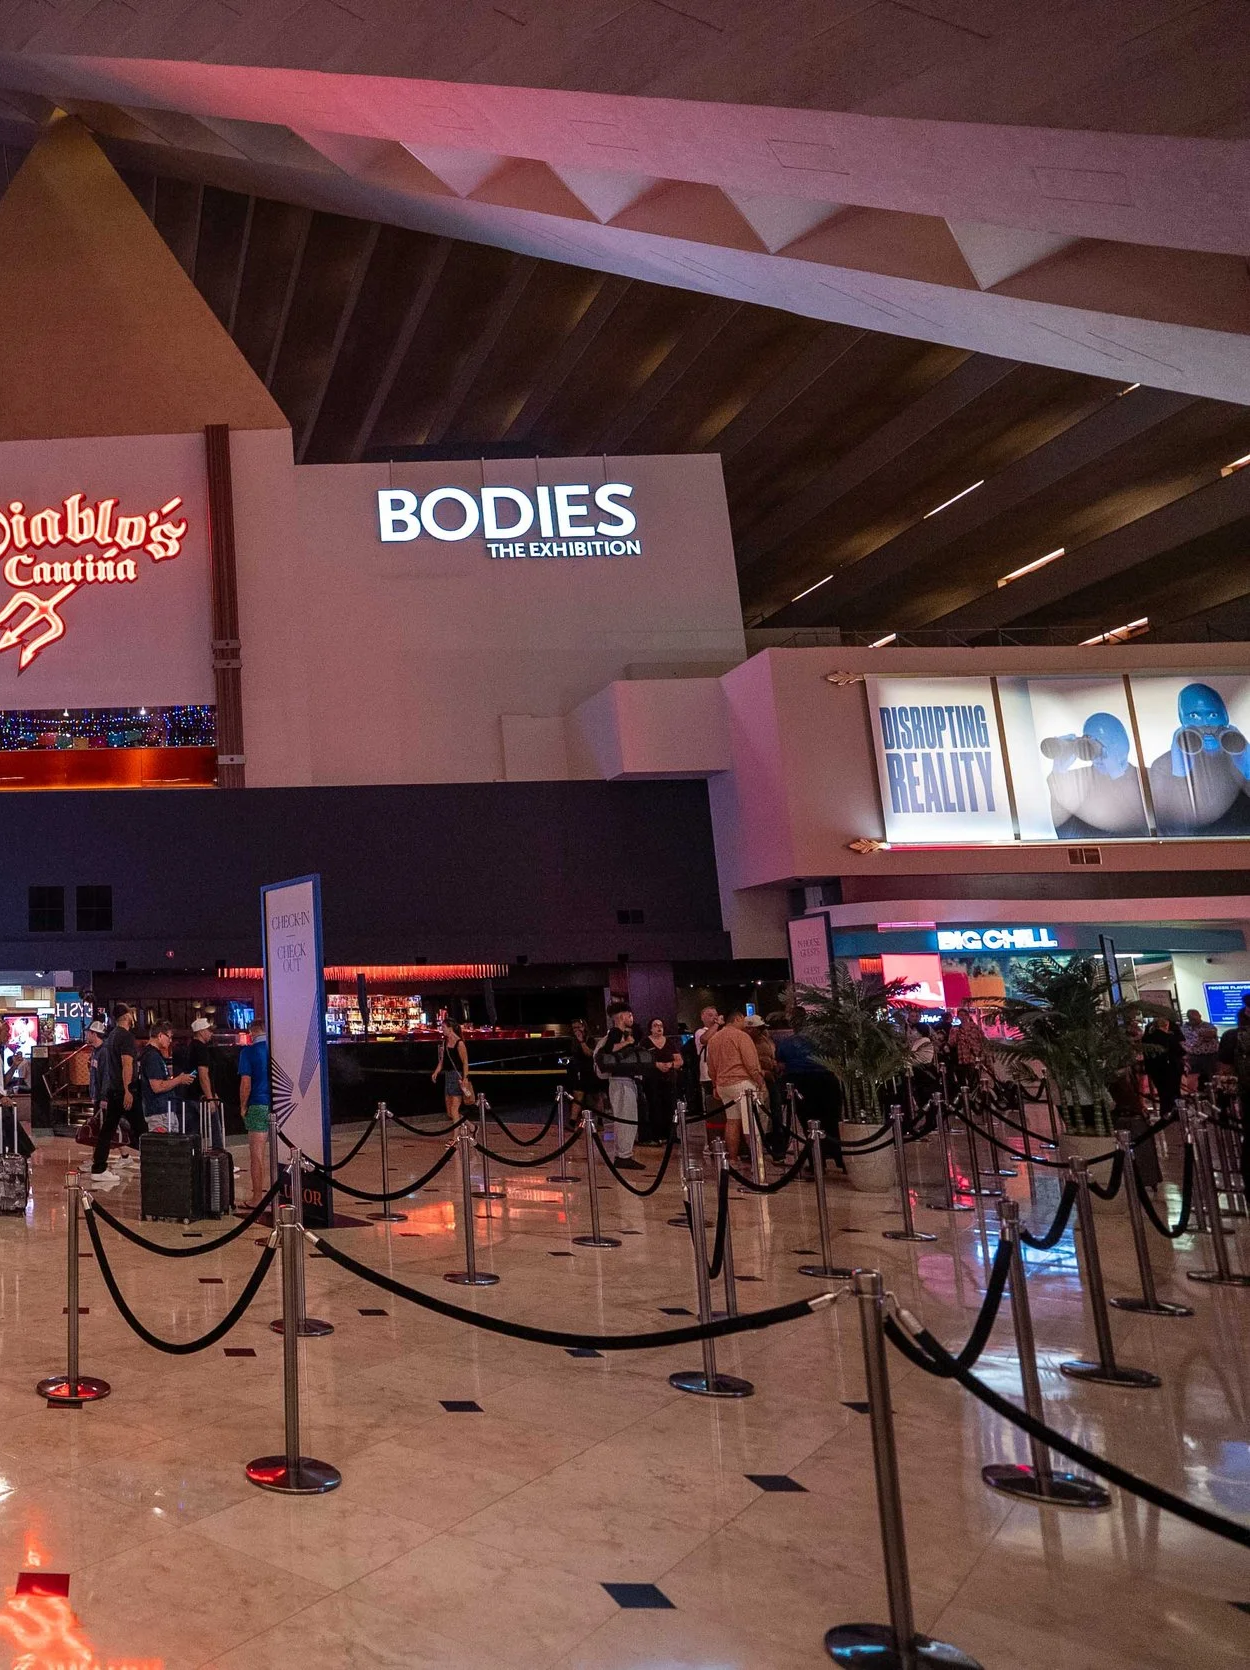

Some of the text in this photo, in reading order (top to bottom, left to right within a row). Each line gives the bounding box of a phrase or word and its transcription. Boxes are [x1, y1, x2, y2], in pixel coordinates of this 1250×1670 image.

[377, 483, 637, 542] BODIES
[486, 539, 642, 559] THE EXHIBITION
[879, 704, 990, 751] DISRUPTING
[886, 751, 996, 814] REALITY
[271, 910, 310, 930] CHECK-IN
[937, 928, 1058, 950] BIG CHILL
[277, 943, 306, 960] CHECK
[282, 958, 301, 973] OUT
